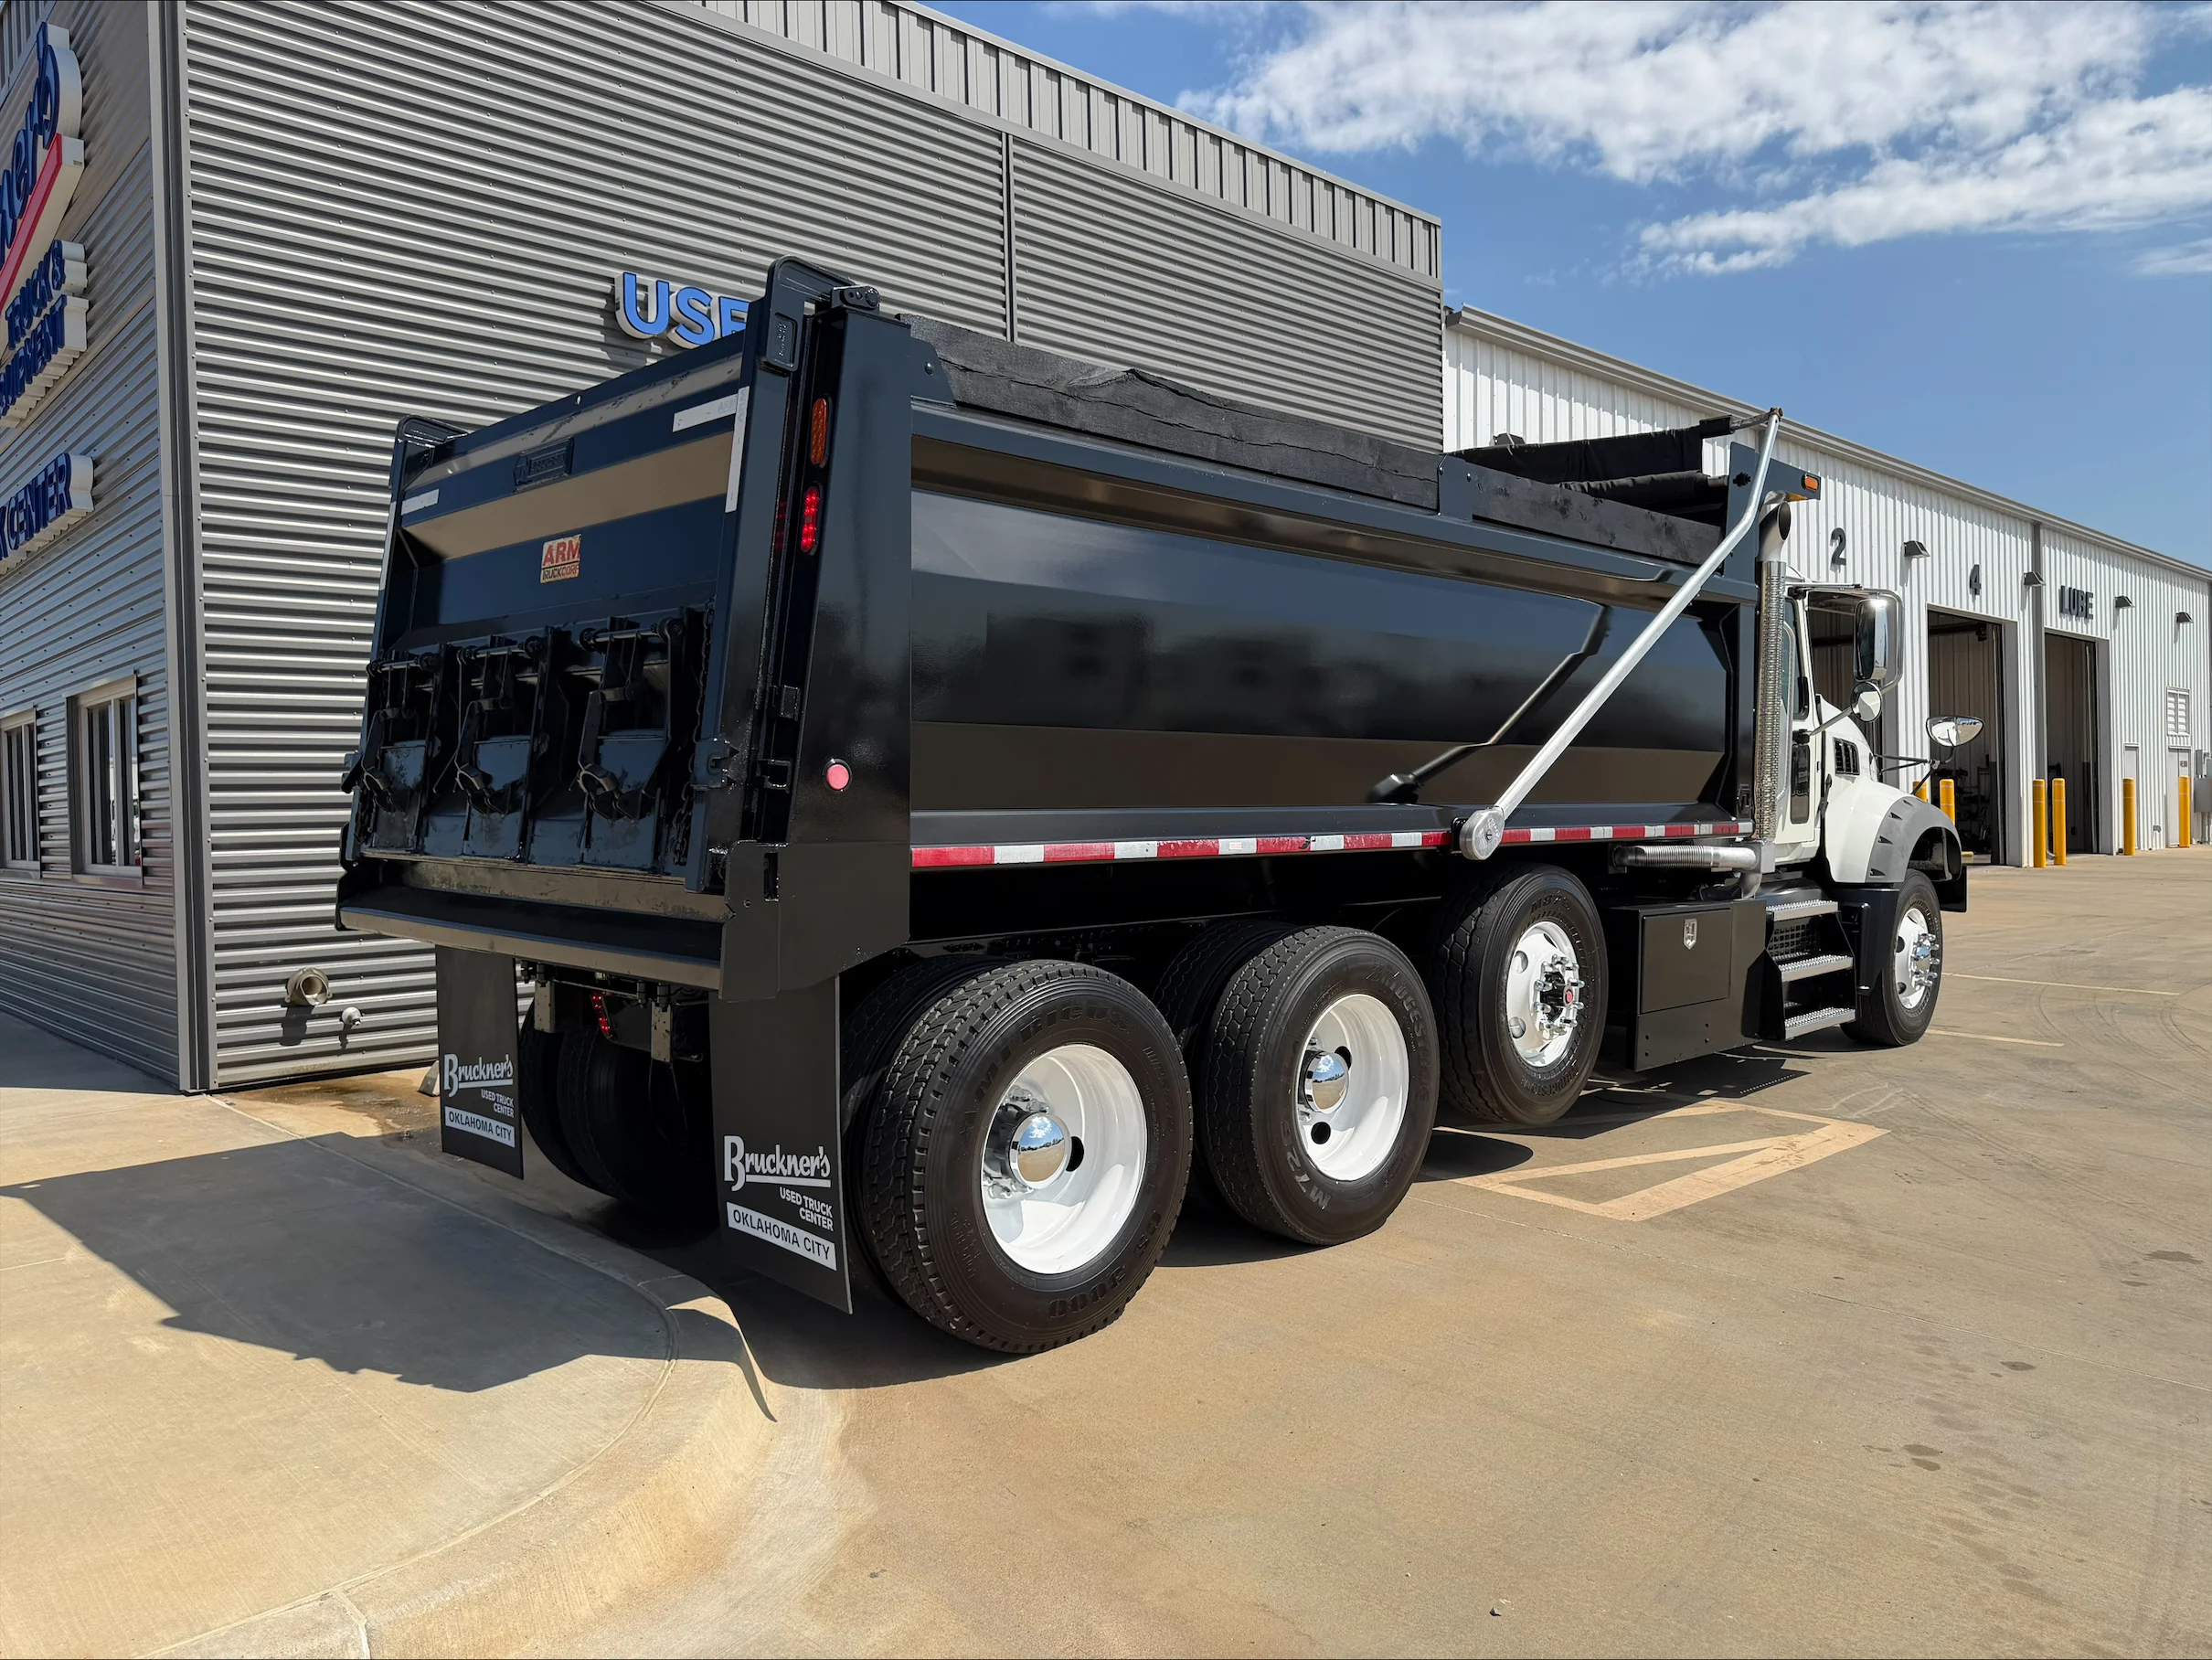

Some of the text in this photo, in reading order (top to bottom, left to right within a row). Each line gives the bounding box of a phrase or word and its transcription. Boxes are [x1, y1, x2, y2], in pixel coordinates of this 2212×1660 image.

[623, 271, 750, 346] USE
[7, 452, 72, 550] CENTER
[542, 538, 581, 567] ARM
[1830, 527, 1846, 566] 2
[1969, 564, 1982, 595] 4
[2059, 585, 2094, 621] LUBE
[444, 1053, 514, 1098] Bruckner's
[481, 1089, 514, 1108] USED TRUCK
[494, 1102, 515, 1118] CENTER
[448, 1111, 513, 1141] OKLAHOMA CITY
[724, 1135, 831, 1192] Bruckner's
[779, 1186, 834, 1218] USED TRUCK
[732, 1208, 830, 1261] OKLAHOMA CITY
[798, 1207, 834, 1232] CENTER
